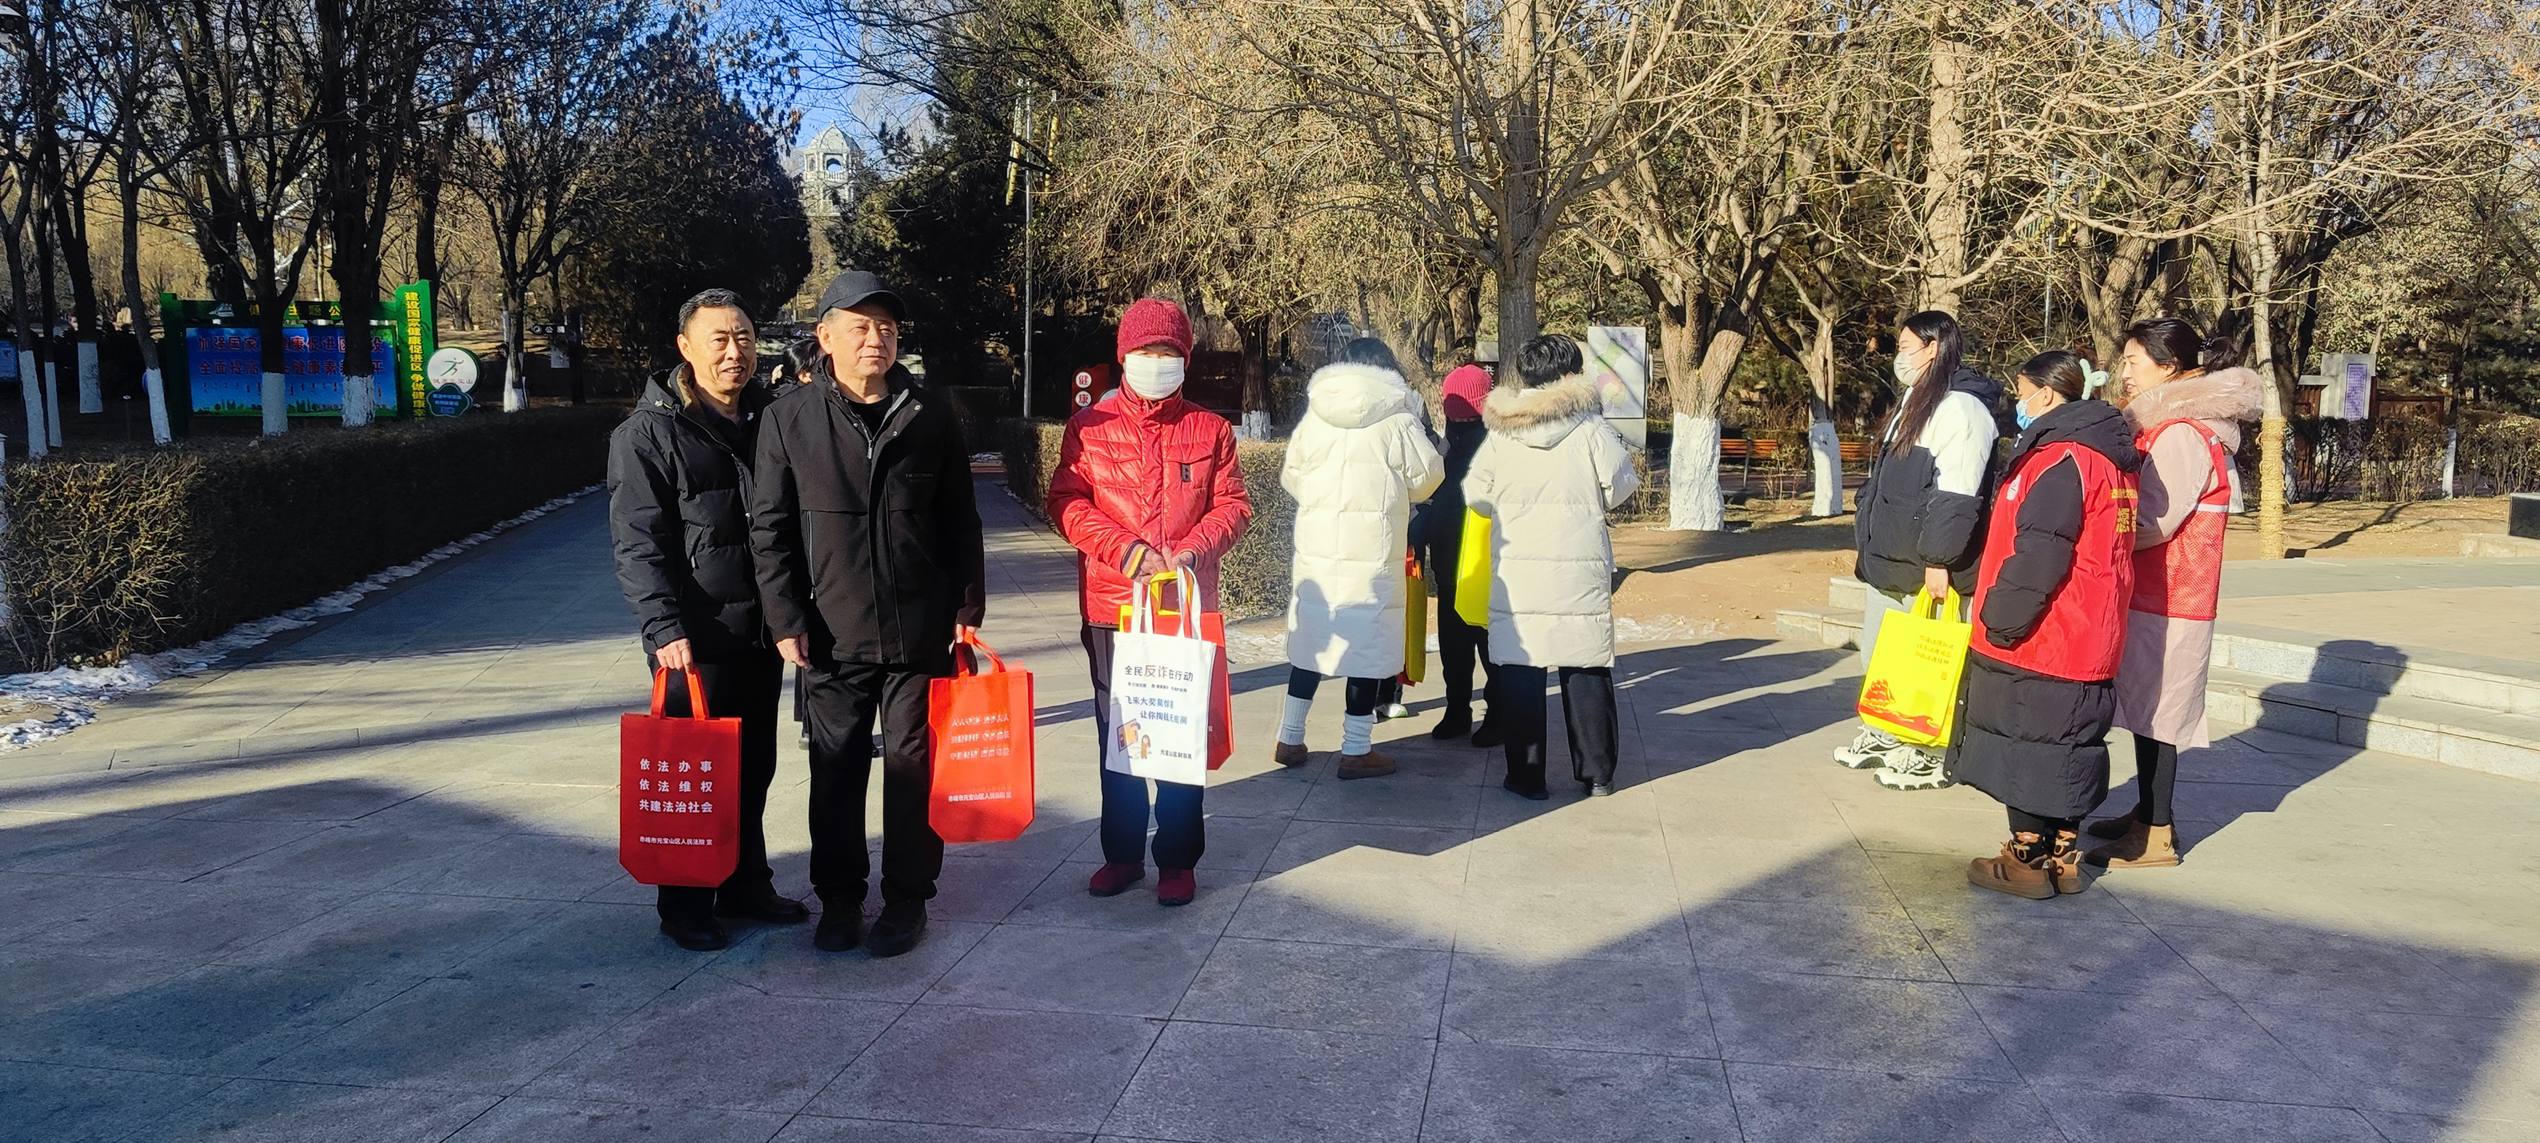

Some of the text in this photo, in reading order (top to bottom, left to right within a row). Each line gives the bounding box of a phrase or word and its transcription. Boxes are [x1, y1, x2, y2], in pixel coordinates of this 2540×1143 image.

[1078, 375, 1089, 405] 健康
[1124, 664, 1194, 683] 全民反诈在行动
[639, 758, 713, 773] 依法办事
[639, 779, 713, 793] 依法维权
[639, 799, 713, 814] 共建法治社会
